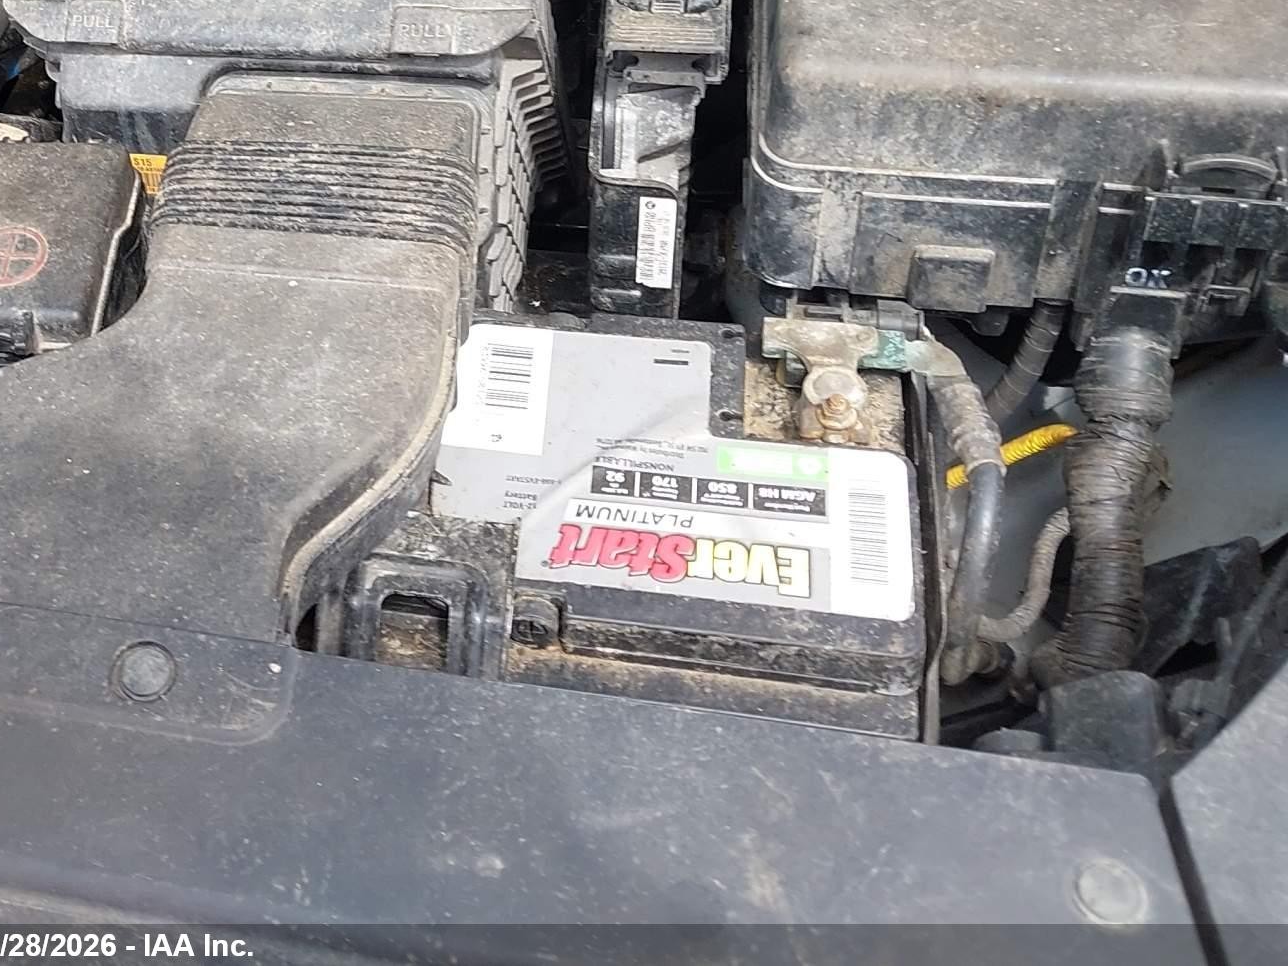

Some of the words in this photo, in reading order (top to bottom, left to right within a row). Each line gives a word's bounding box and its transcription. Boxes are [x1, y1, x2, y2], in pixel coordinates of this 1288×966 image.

[71, 14, 115, 29] PULL
[399, 22, 447, 38] PULL
[604, 471, 626, 483] 92
[652, 476, 679, 488] 170
[708, 481, 738, 495] 850
[781, 488, 816, 503] AGM
[575, 503, 693, 529] PLATINUM
[549, 524, 811, 598] EverStart
